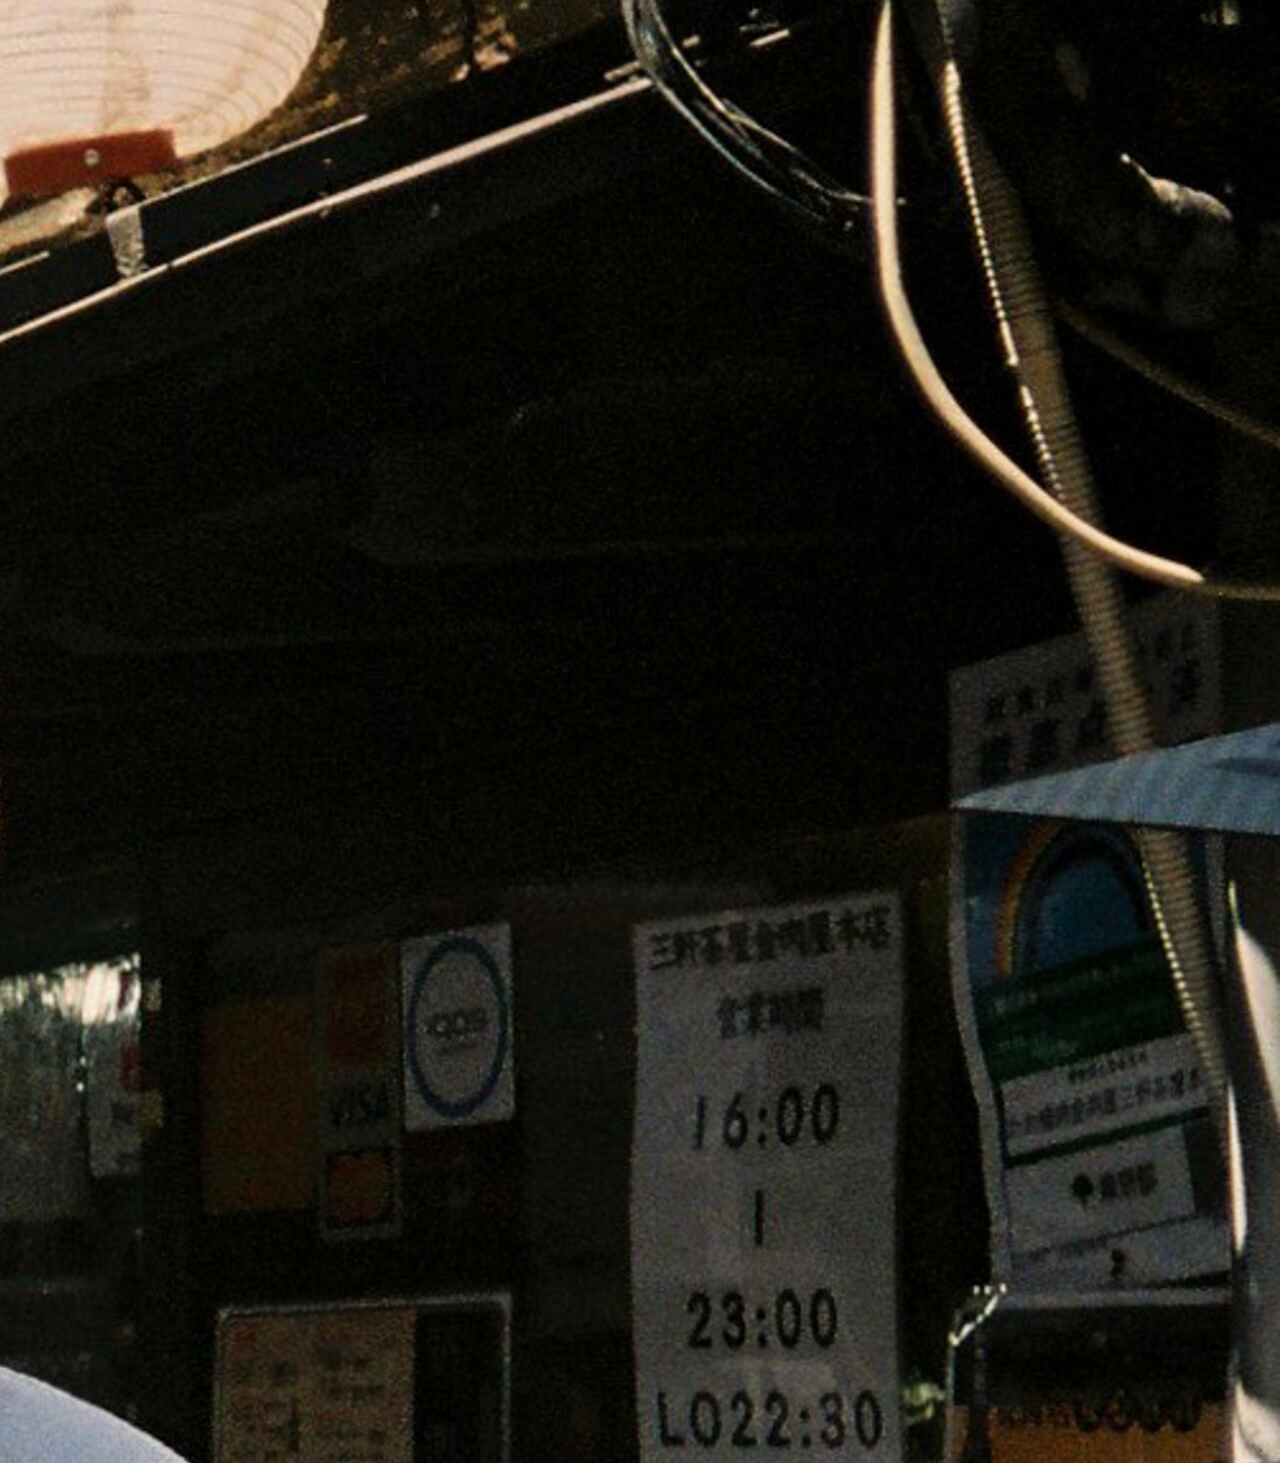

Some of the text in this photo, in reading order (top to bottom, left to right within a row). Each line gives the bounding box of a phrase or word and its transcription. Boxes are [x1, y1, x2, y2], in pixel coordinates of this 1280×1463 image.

[694, 1083, 839, 1151] 16:00
[687, 1288, 838, 1349] 23:00
[656, 1389, 883, 1449] LO22:30
